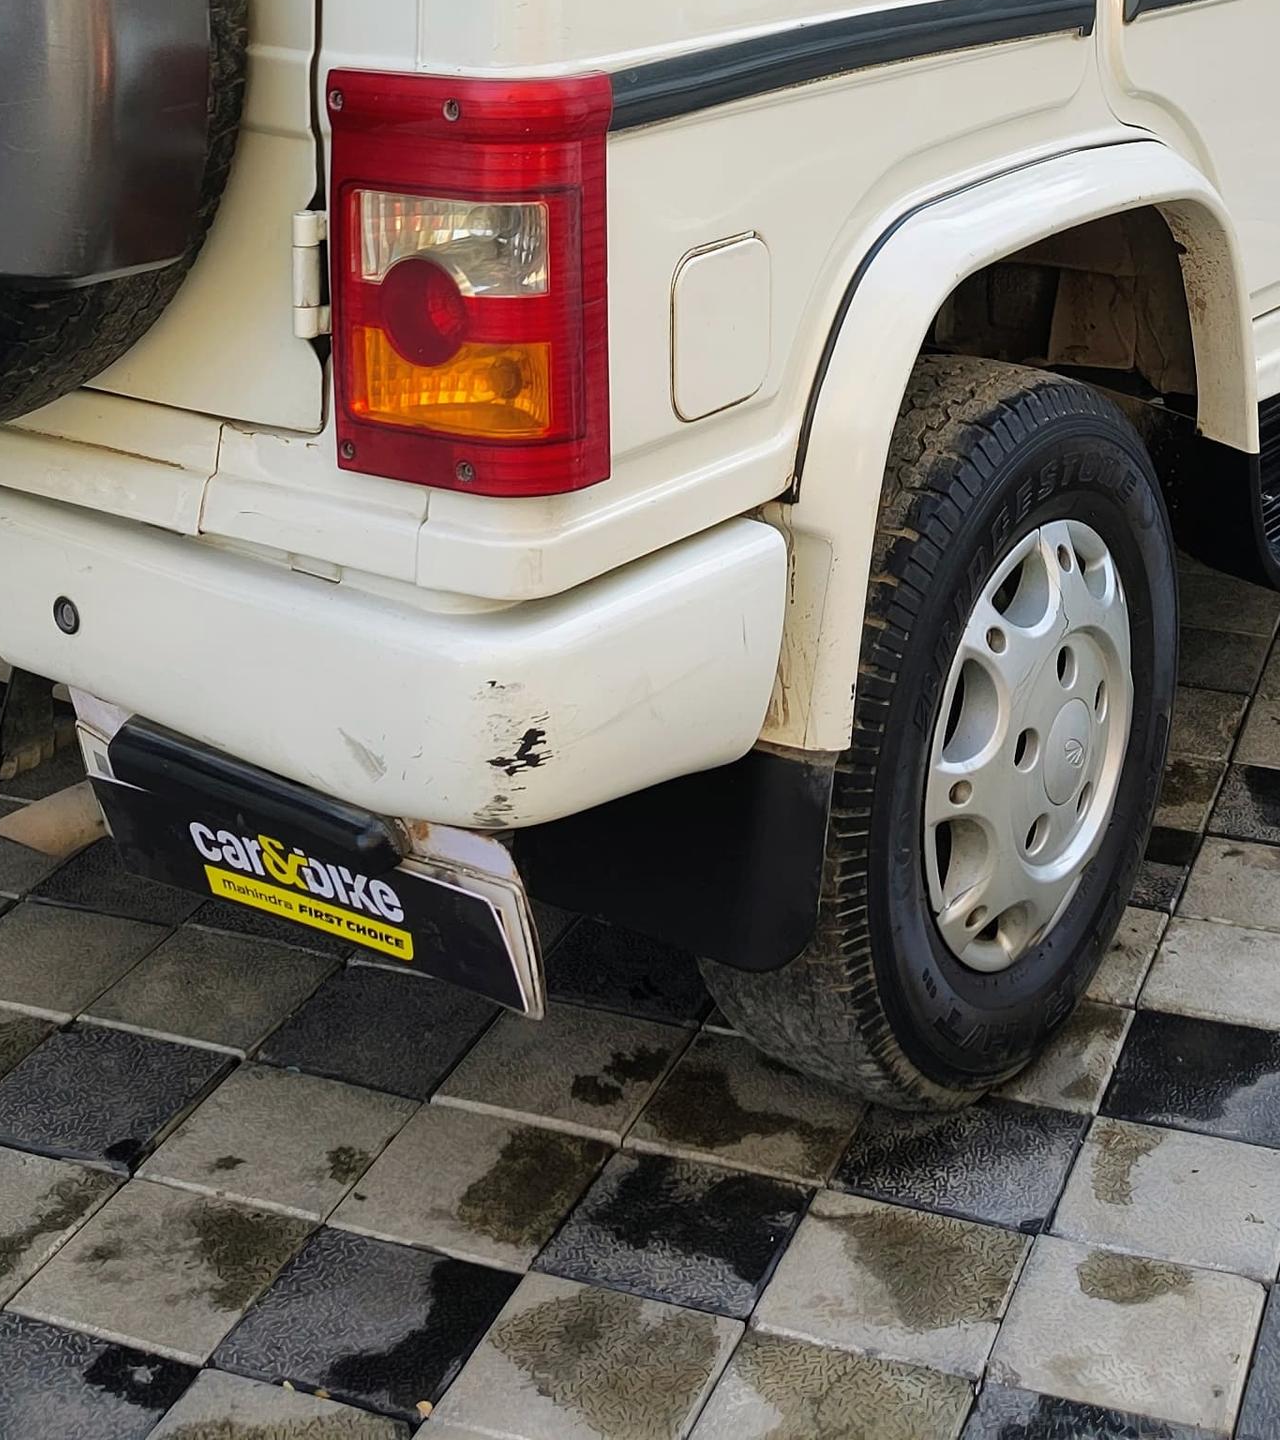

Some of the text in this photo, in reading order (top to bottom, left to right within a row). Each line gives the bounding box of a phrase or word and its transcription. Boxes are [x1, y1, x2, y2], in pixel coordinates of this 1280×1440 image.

[188, 821, 405, 923] car&bike
[298, 903, 343, 928] FIRST
[346, 920, 405, 950] CHOICE
